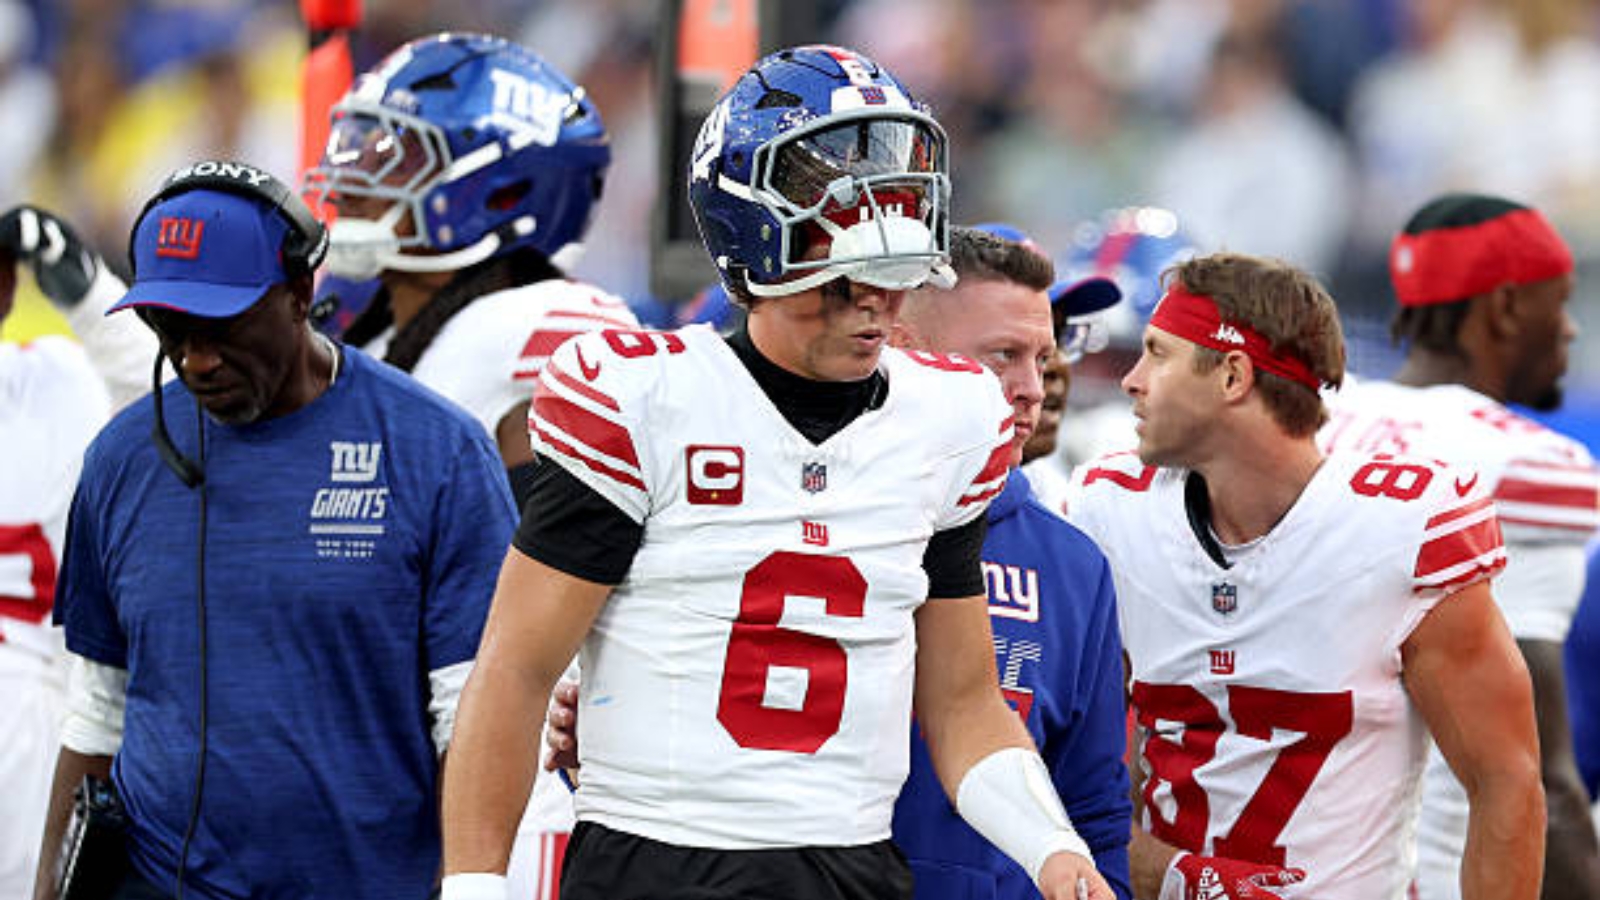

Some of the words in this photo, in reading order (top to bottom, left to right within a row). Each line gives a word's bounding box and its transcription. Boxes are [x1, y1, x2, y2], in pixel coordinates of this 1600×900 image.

[172, 161, 270, 187] SONY
[156, 217, 204, 259] ny
[330, 441, 382, 481] ny
[690, 449, 741, 490] C
[1082, 448, 1158, 492] 7
[1349, 453, 1448, 502] 8
[310, 488, 389, 518] GIANTS
[801, 519, 829, 547] ny
[980, 561, 1040, 623] ny
[716, 550, 869, 755] 6
[1209, 648, 1235, 675] ny
[1132, 680, 1355, 868] 87
